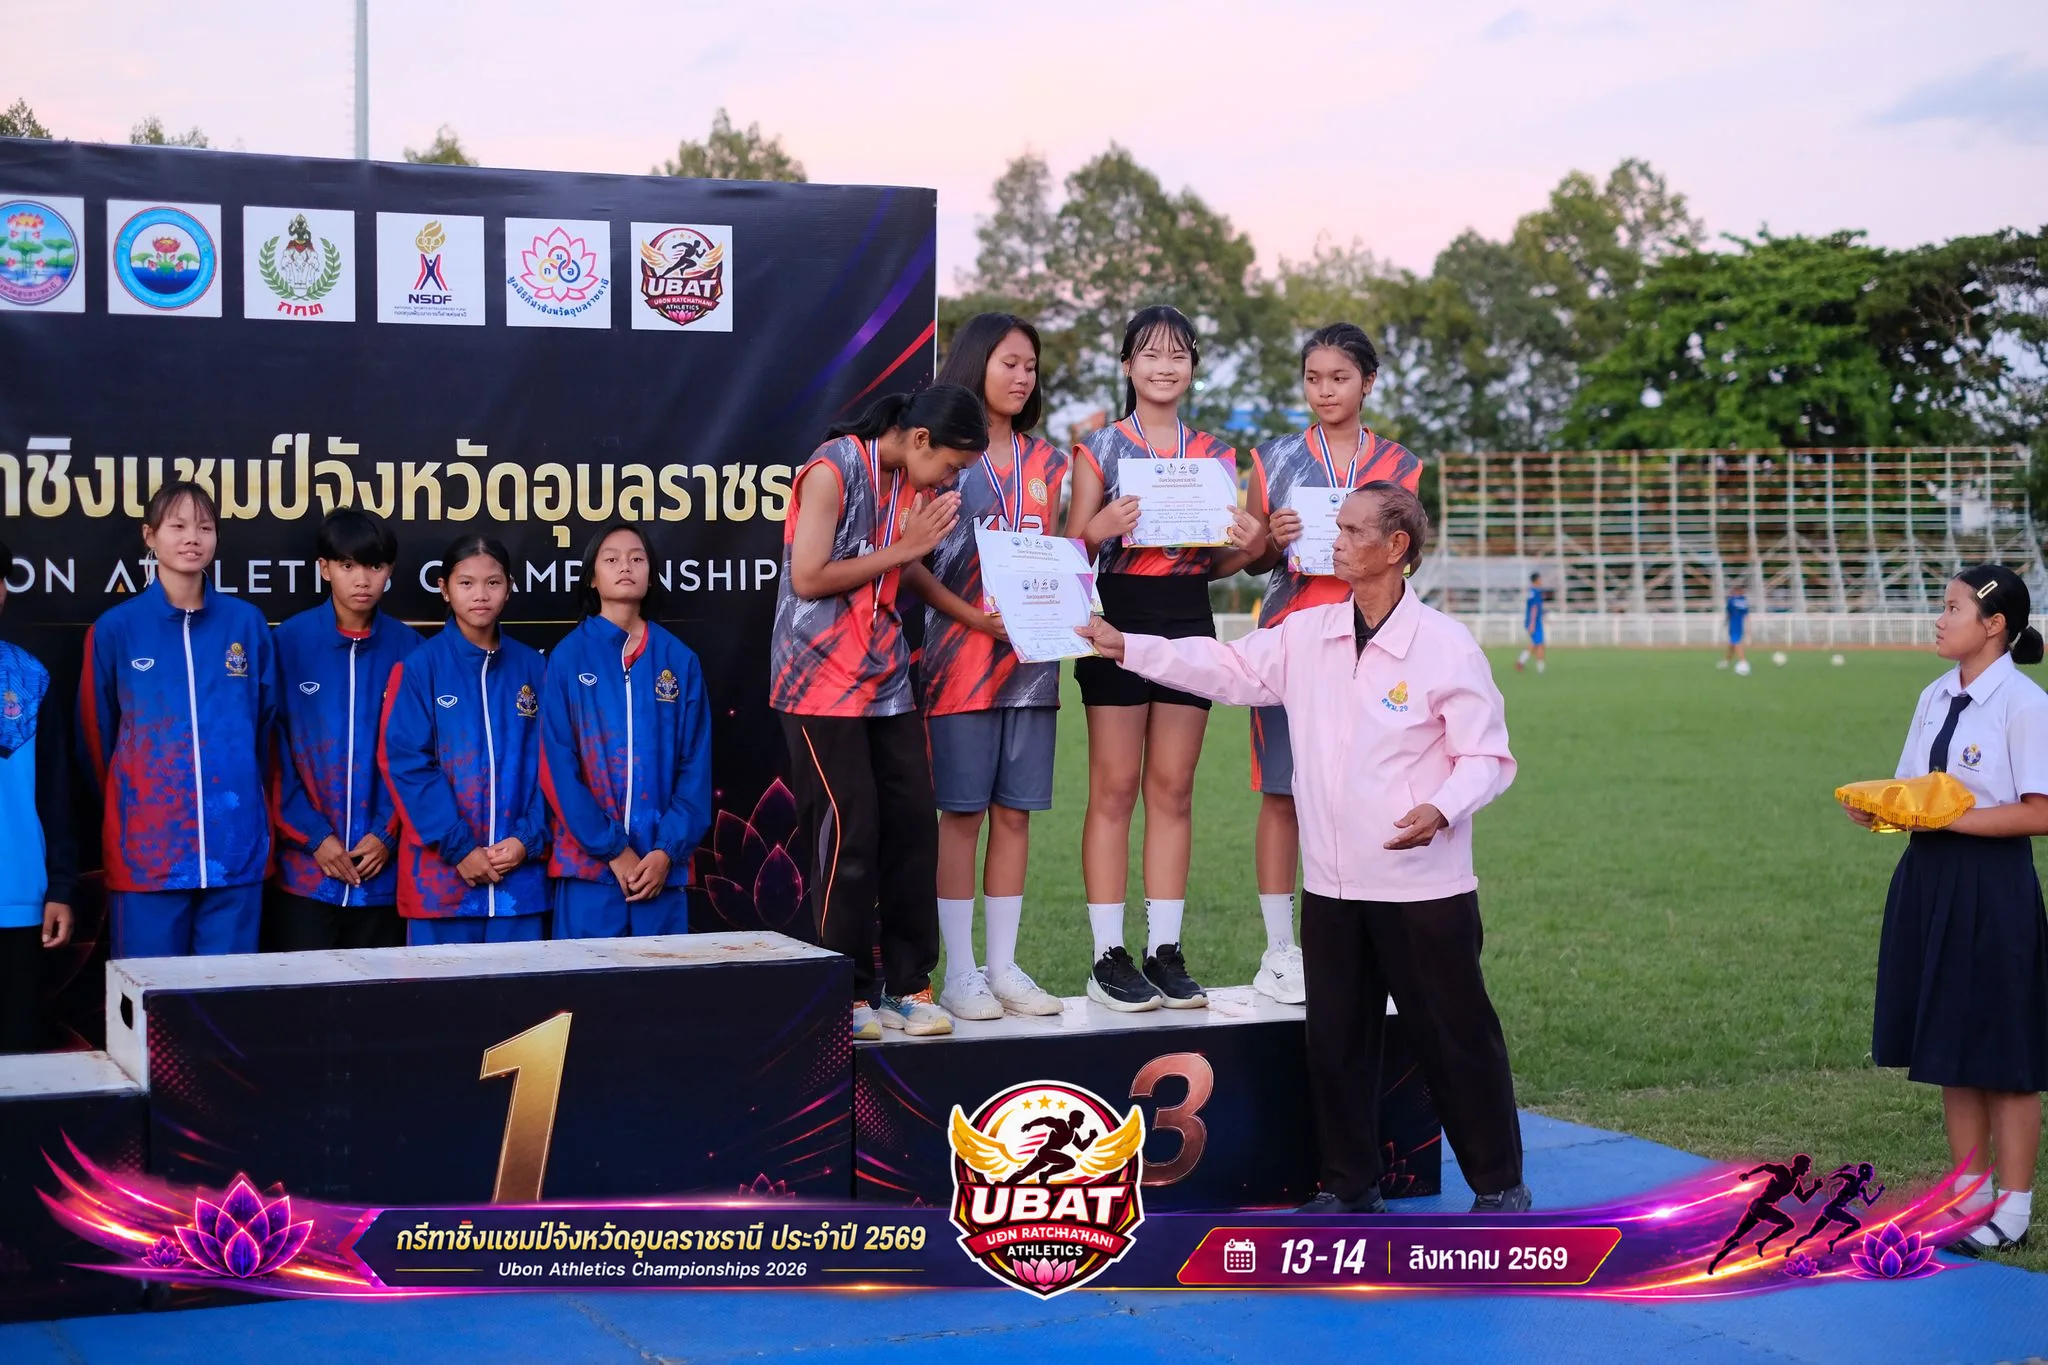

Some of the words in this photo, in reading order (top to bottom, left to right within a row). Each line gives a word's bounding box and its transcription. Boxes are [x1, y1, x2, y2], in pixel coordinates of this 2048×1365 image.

[408, 293, 453, 305] NSDF
[647, 277, 717, 298] UBAT
[277, 301, 324, 317] กกท
[3, 557, 75, 593] ON
[480, 1012, 573, 1205] 1
[1128, 1052, 1214, 1186] 3
